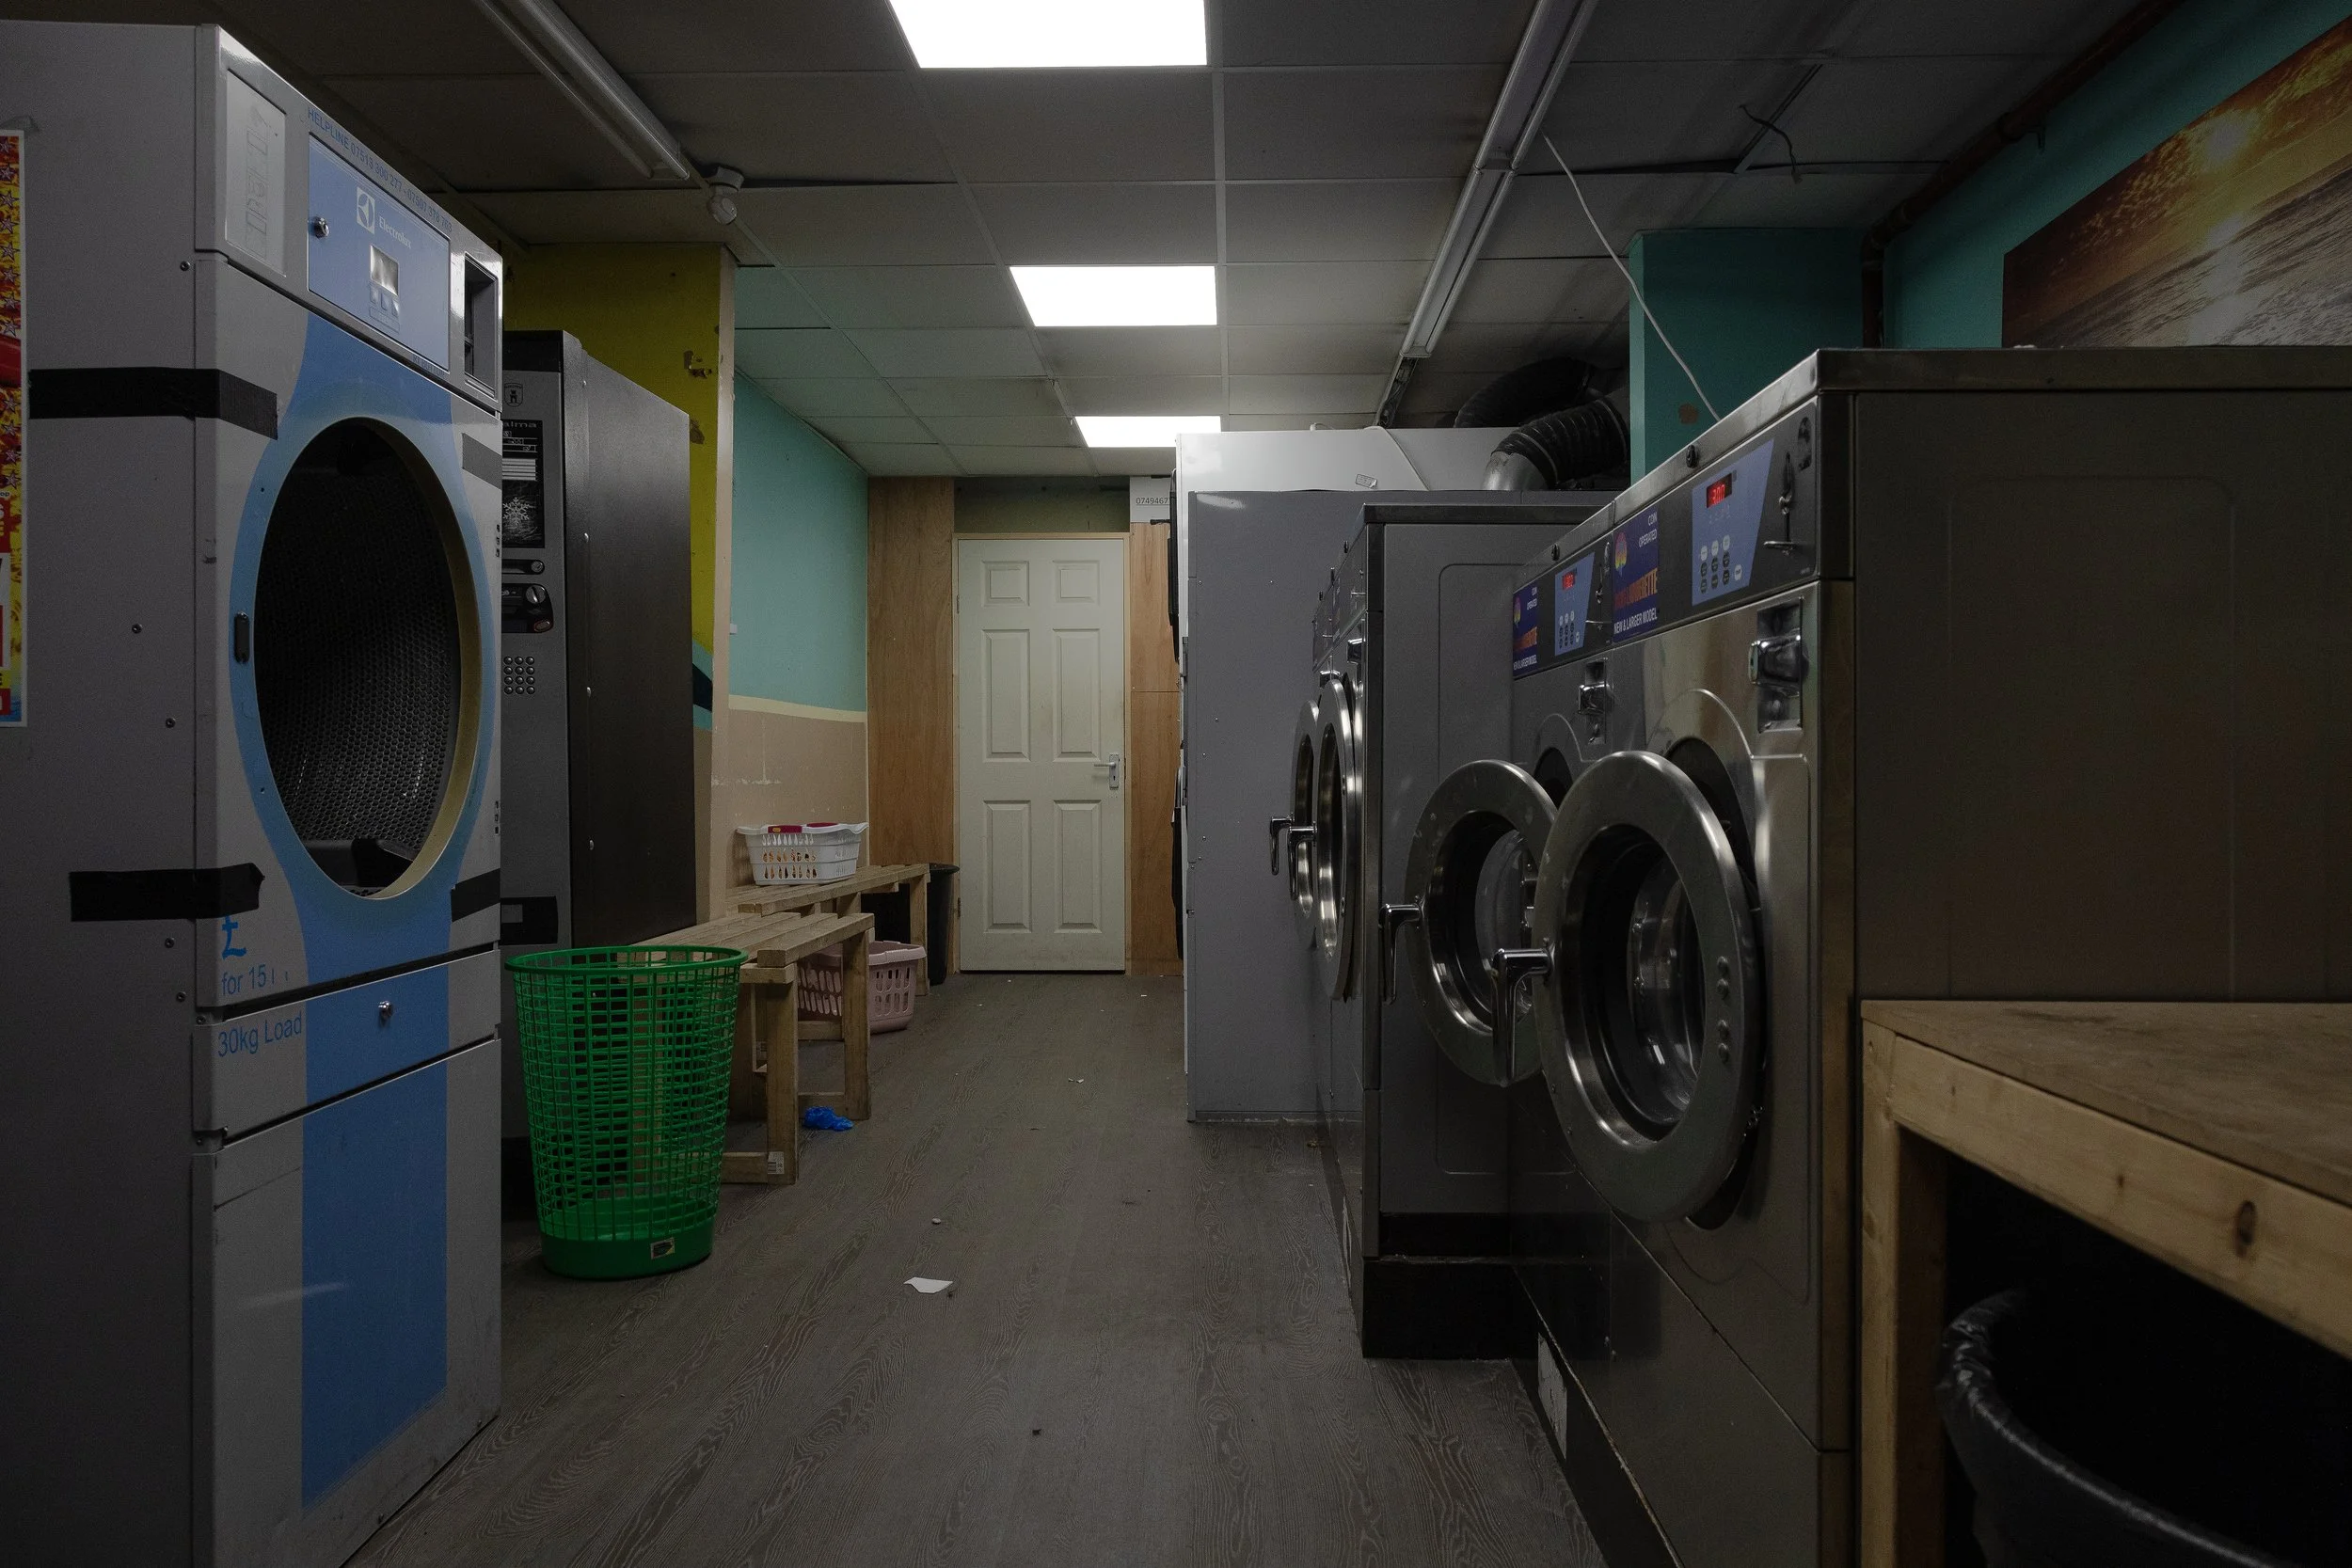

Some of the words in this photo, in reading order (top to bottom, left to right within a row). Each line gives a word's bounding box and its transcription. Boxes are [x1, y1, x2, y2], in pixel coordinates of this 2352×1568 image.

[308, 106, 350, 150] HELPLINE
[379, 215, 412, 249] Electrolux
[1638, 529, 1658, 547] OPERATED
[1613, 620, 1623, 635] NEW
[1626, 612, 1643, 631] LARGER
[1642, 607, 1658, 625] MODEL
[221, 972, 244, 996] for
[248, 963, 267, 989] 15
[217, 1025, 259, 1057] 30kg
[264, 1011, 302, 1044] Load
